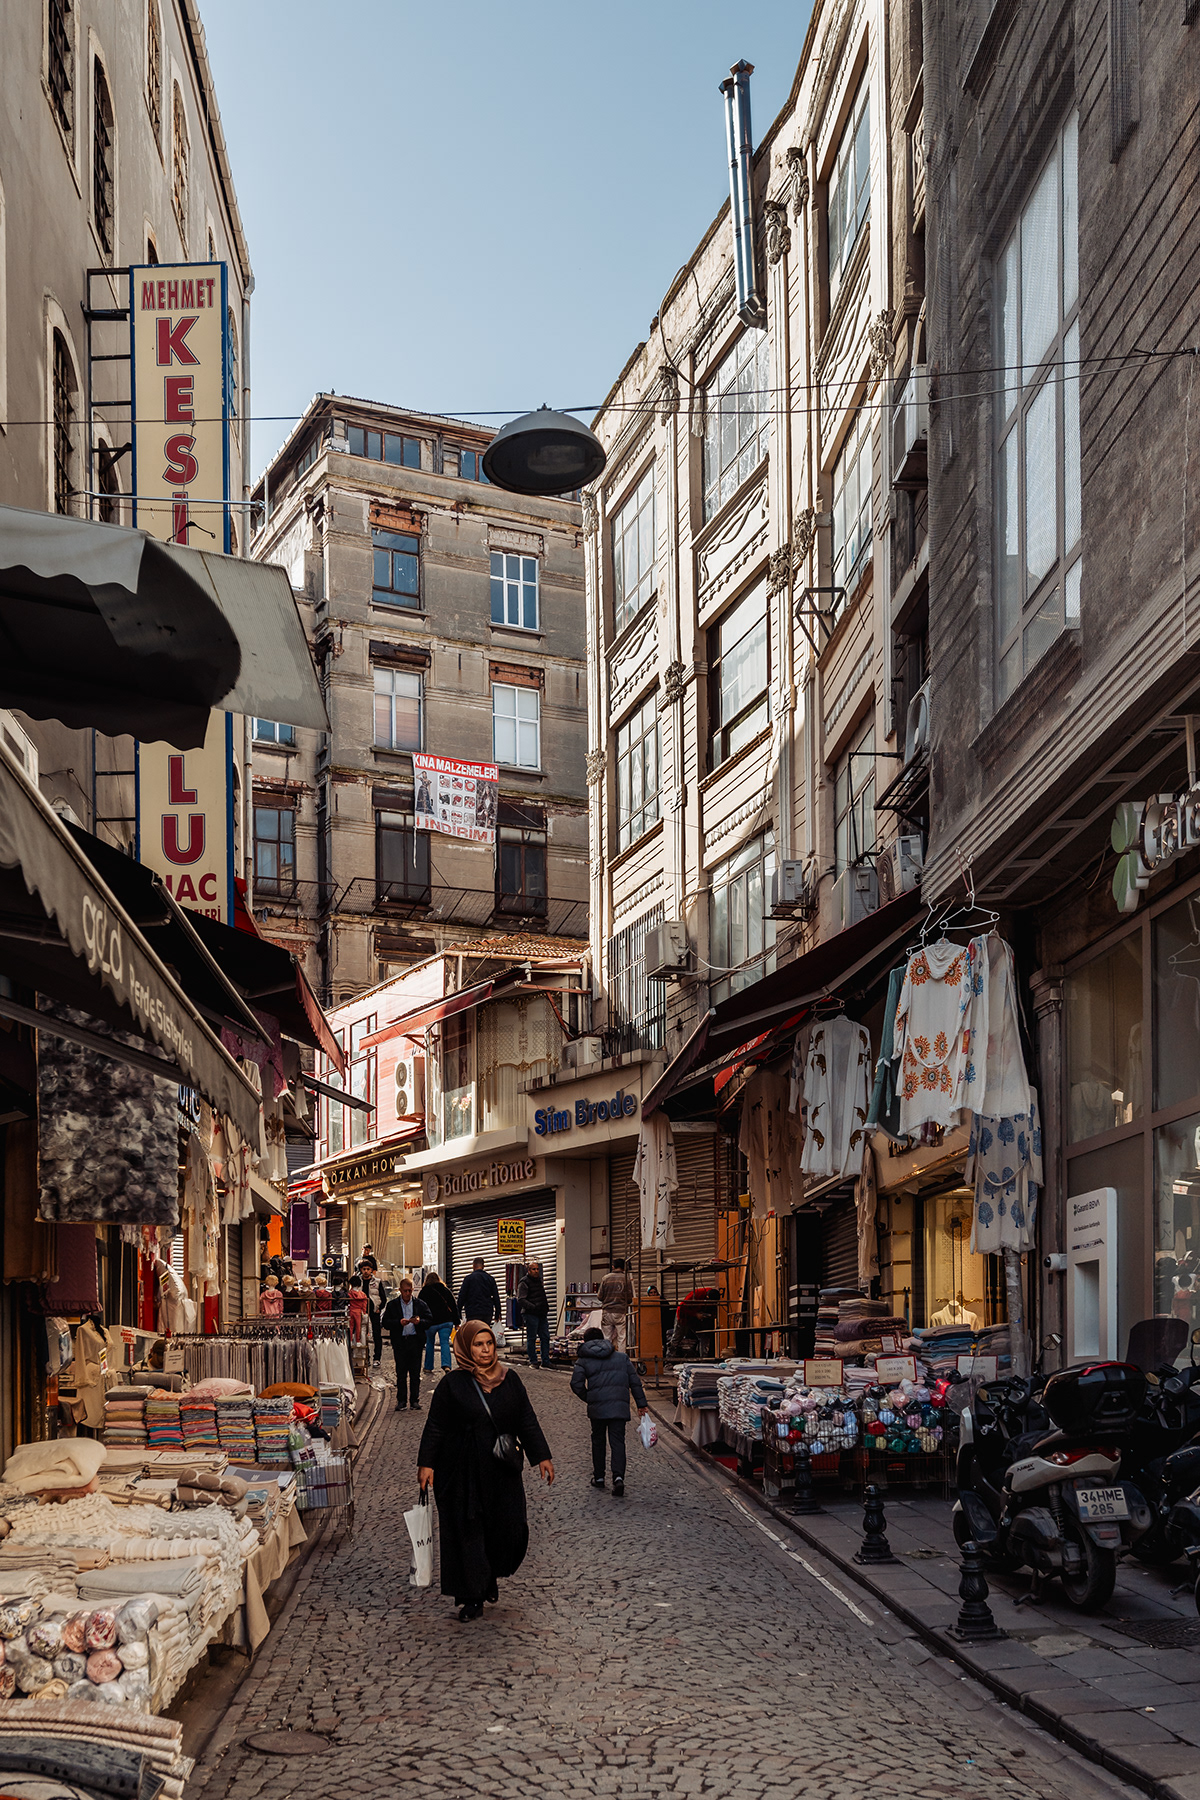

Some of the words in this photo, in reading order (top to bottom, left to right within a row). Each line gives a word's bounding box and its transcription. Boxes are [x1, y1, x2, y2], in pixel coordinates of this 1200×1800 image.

[141, 278, 216, 311] MEHMET
[413, 754, 436, 770] KINA
[436, 758, 498, 780] MALZEMELERİ
[425, 816, 488, 841] İNDİRİM
[534, 1105, 571, 1136] Sim
[574, 1090, 637, 1128] Brode
[330, 1164, 368, 1185] ÖZKAN
[372, 1154, 407, 1175] HOM
[489, 1158, 537, 1186] Home
[500, 1226, 523, 1234] HAC
[1091, 1504, 1115, 1515] 285
